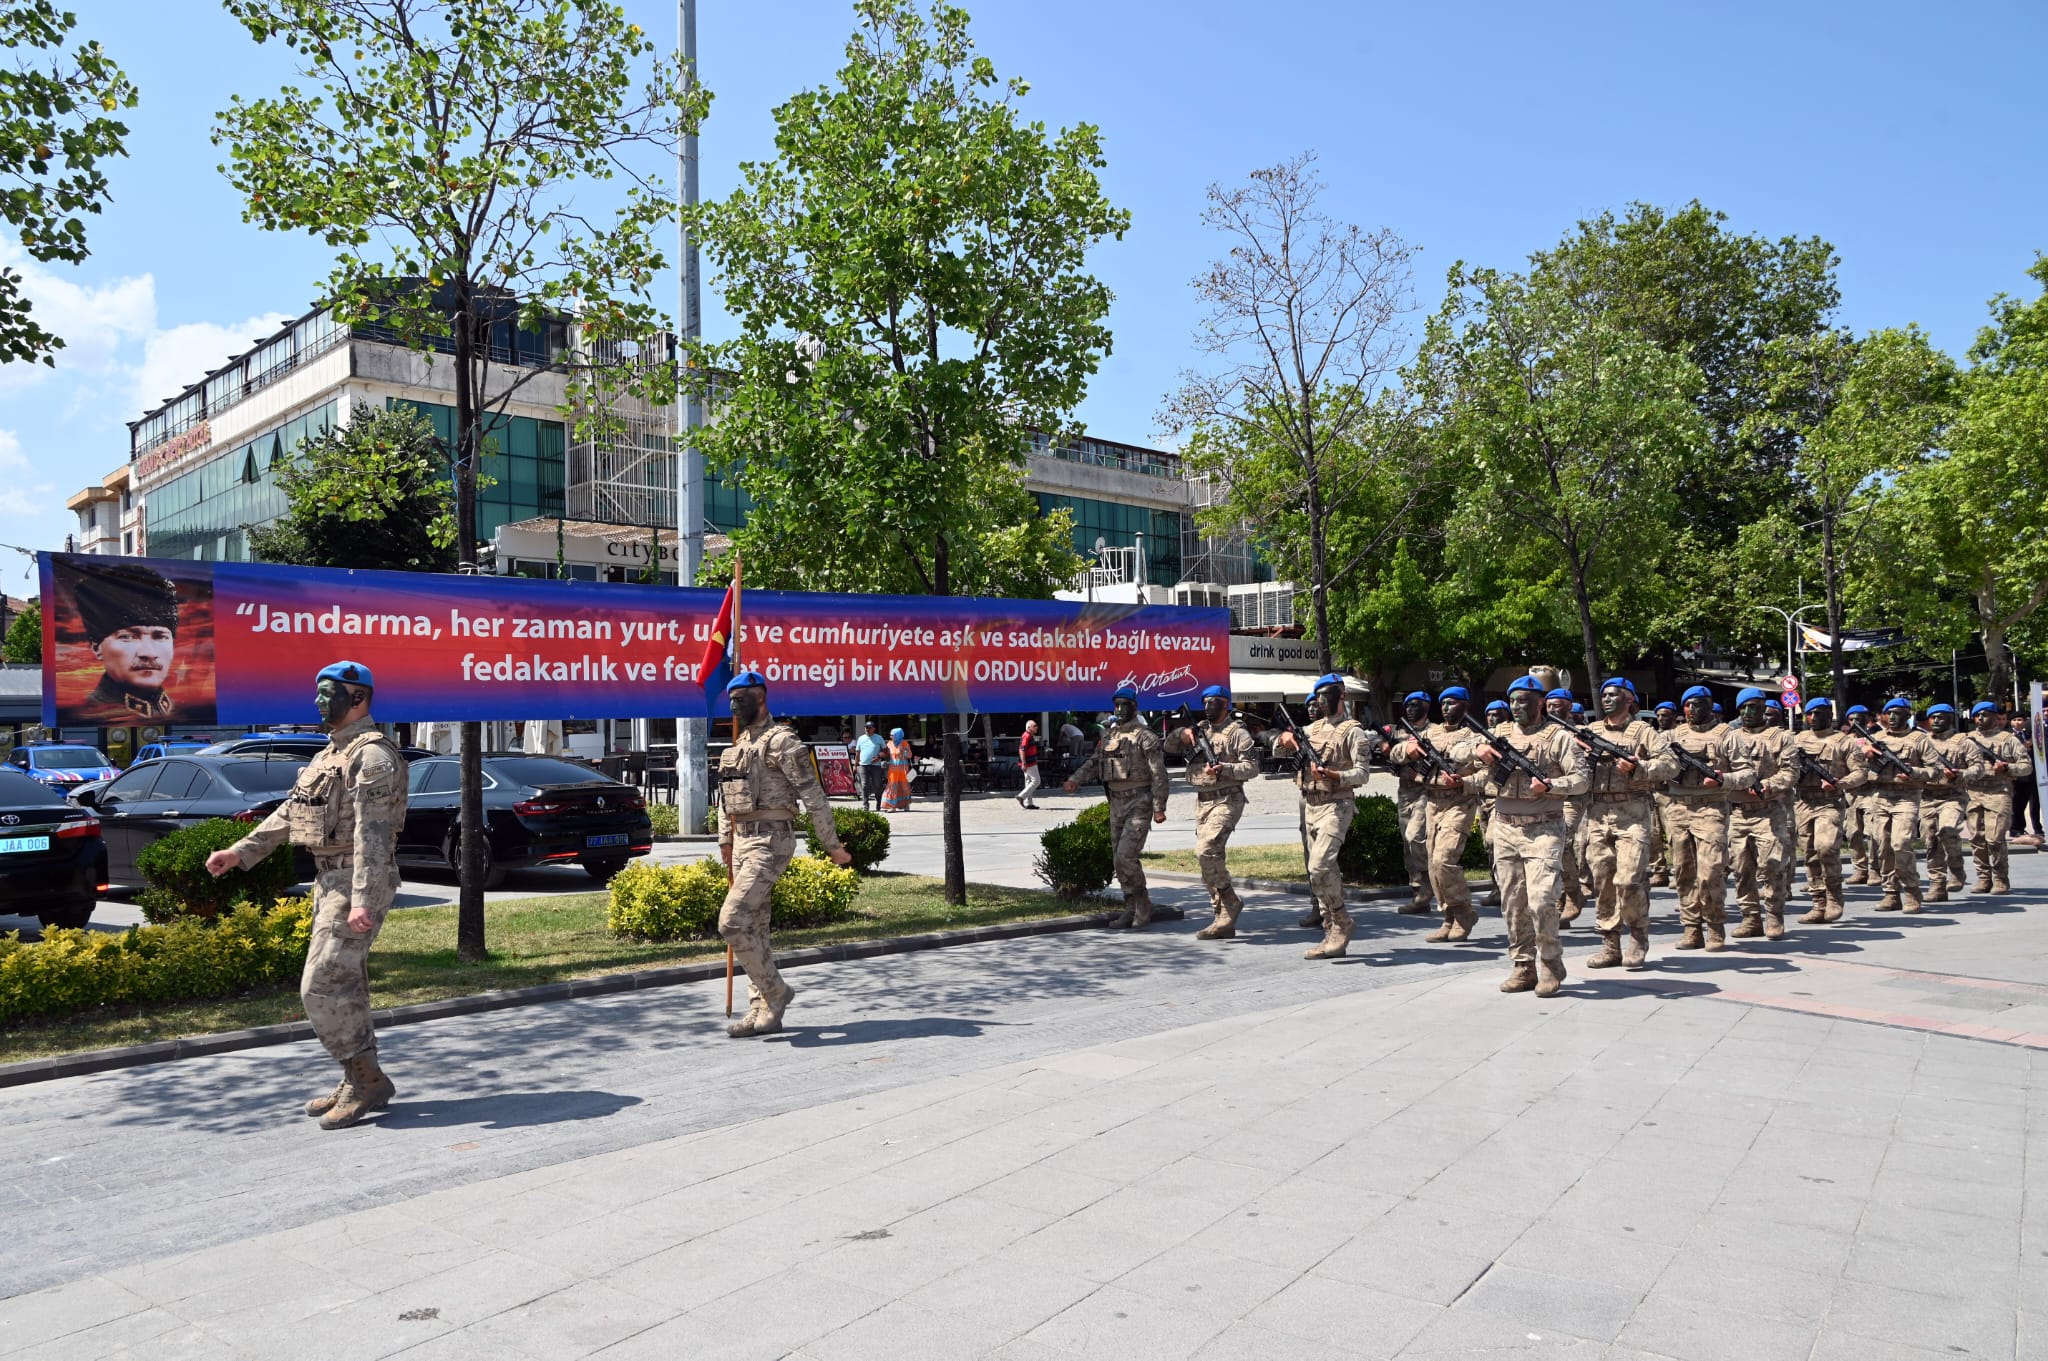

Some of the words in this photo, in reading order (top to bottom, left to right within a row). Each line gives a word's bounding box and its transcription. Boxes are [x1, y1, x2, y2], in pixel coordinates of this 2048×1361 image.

[235, 602, 442, 641] “Jandarma,
[451, 608, 505, 638] her
[511, 618, 612, 640] zaman
[620, 619, 686, 647] yurt,
[755, 625, 784, 643] ve
[789, 621, 935, 651] cumhuriyete
[939, 624, 975, 652] aşk
[980, 631, 1003, 647] ve
[1008, 626, 1101, 650] sadakatle
[1105, 629, 1150, 655] bağlı
[1153, 632, 1216, 654] tevazu,
[1249, 643, 1275, 658] drink
[1278, 645, 1302, 661] good
[461, 653, 618, 681] fedakarlık
[624, 661, 657, 681] ve
[765, 657, 845, 687] örneği
[852, 657, 883, 681] bir
[888, 660, 969, 682] KANUN
[2, 839, 23, 852] JAA
[27, 838, 48, 850] 006
